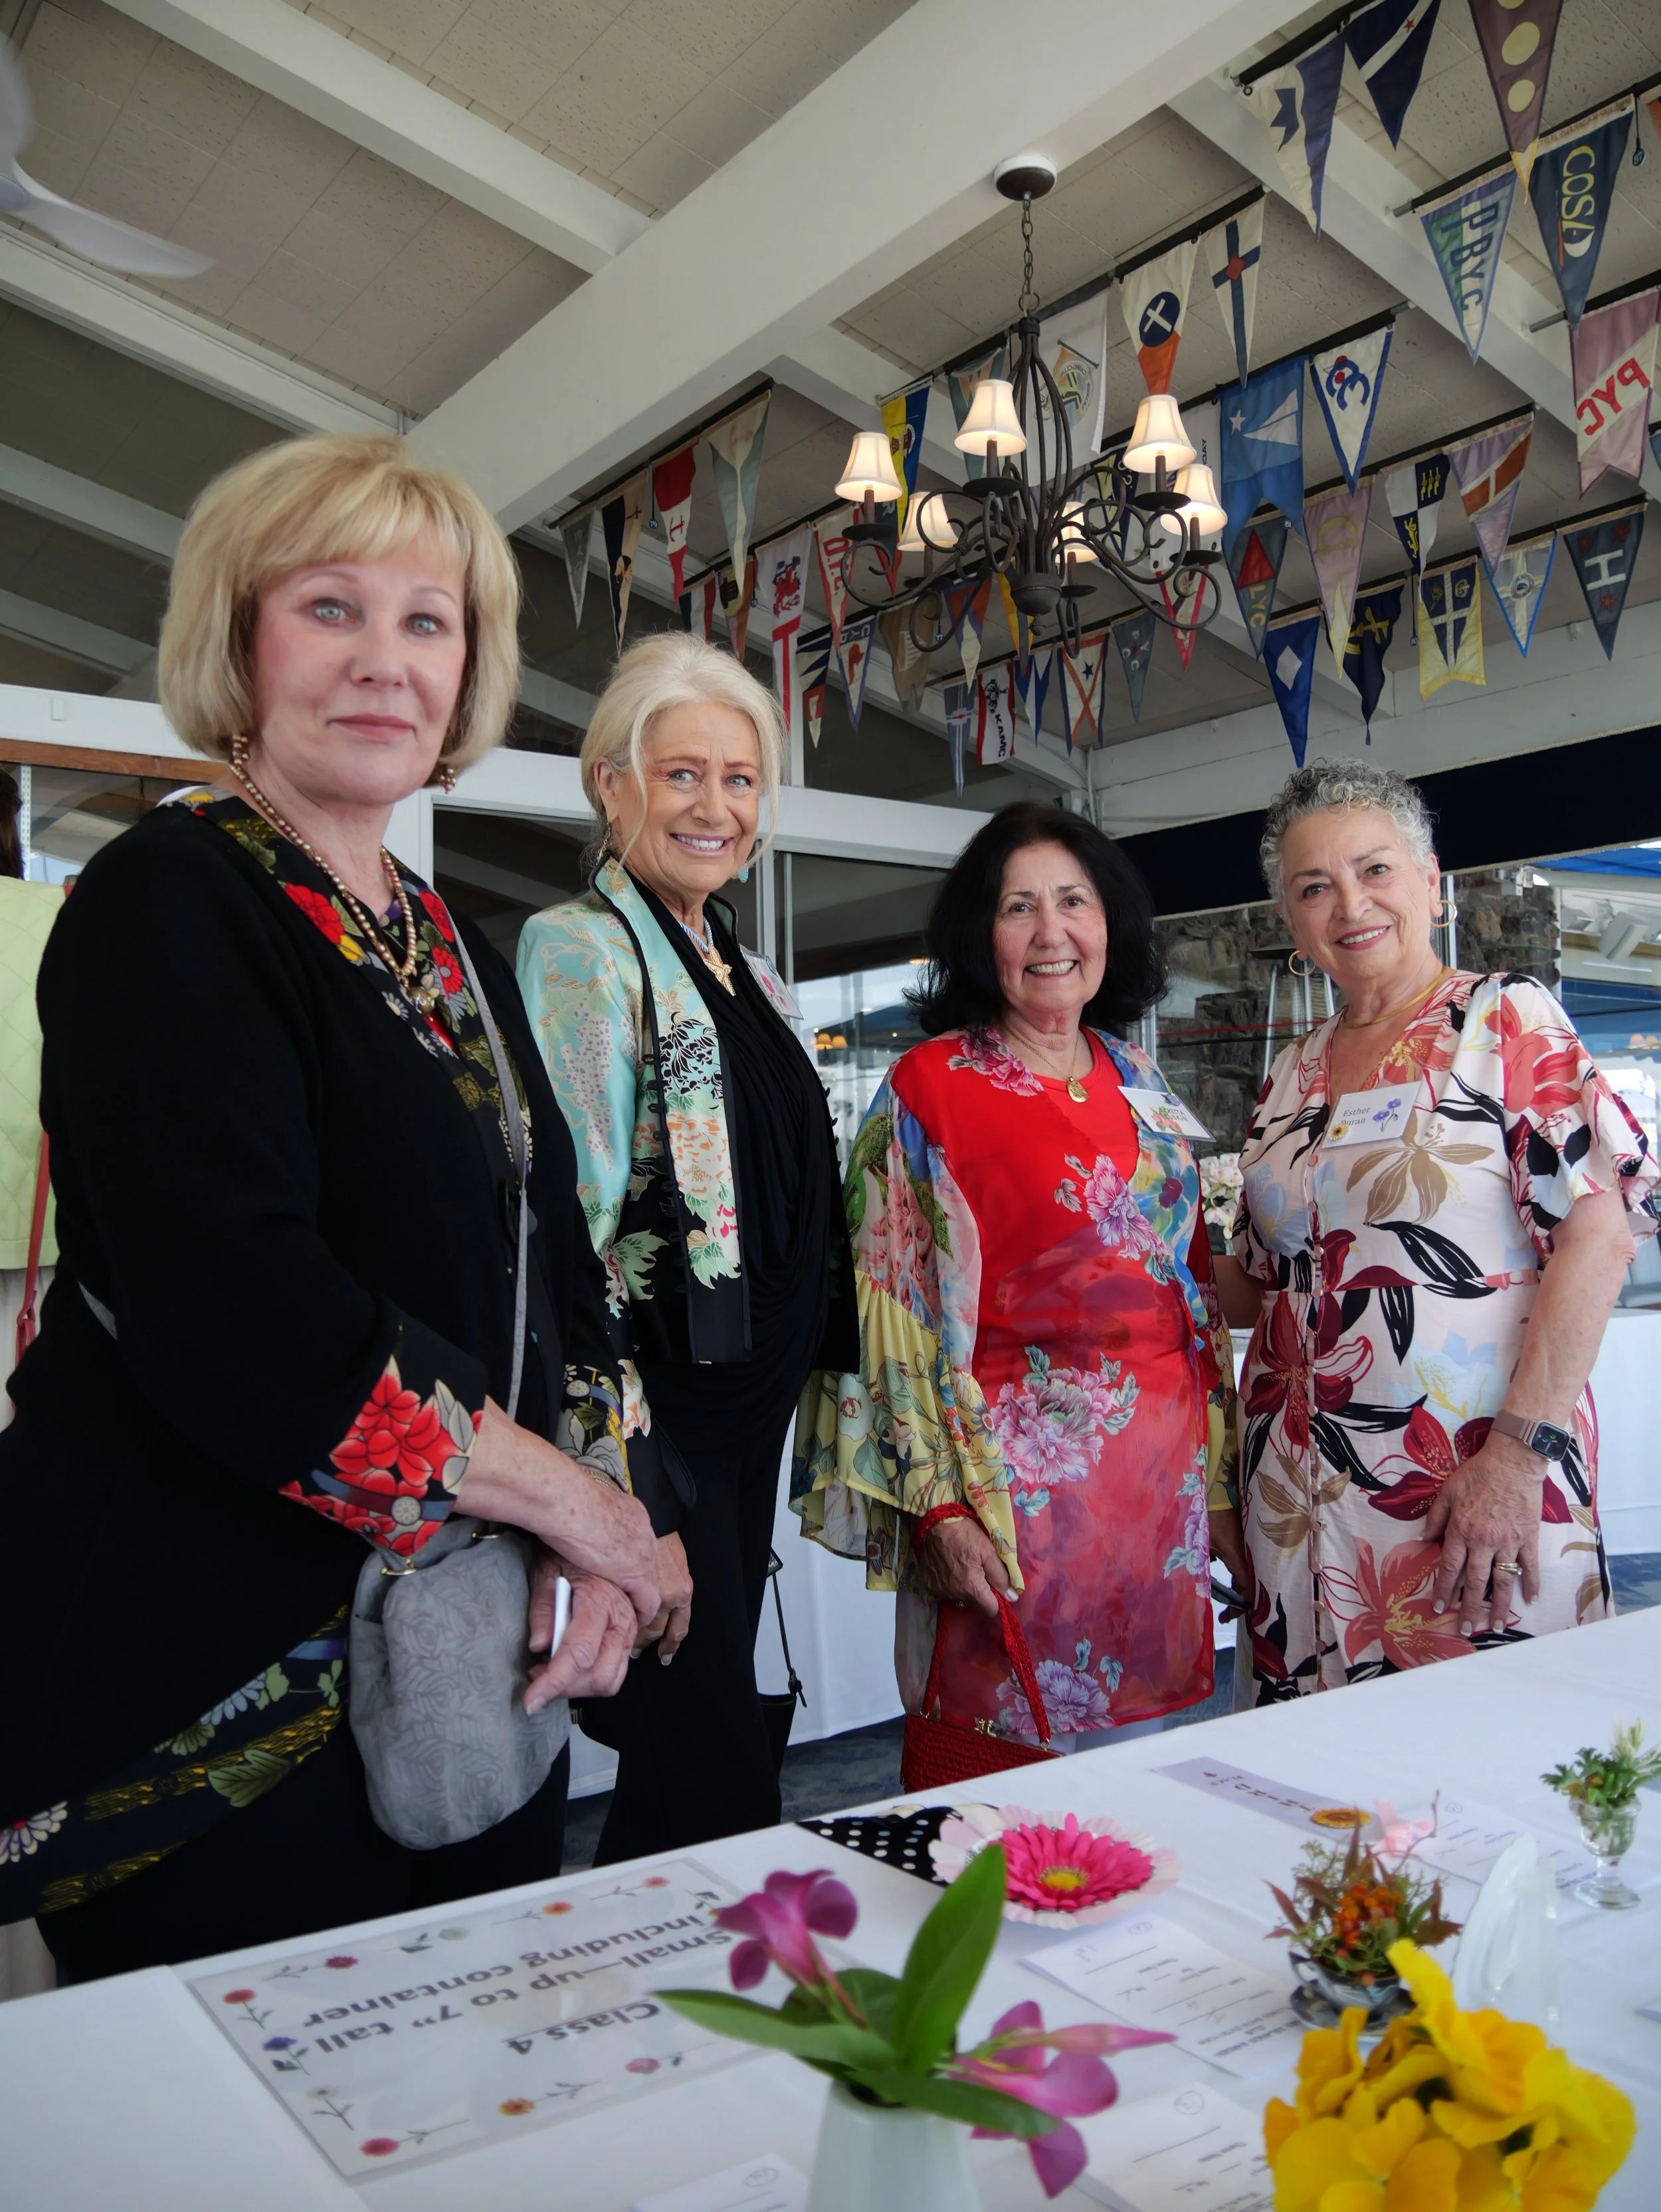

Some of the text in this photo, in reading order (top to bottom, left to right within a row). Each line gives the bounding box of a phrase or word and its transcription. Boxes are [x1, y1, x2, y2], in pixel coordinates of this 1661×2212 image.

[1441, 202, 1499, 311] PBYC
[1585, 549, 1626, 591] H
[1249, 585, 1266, 628] LYC
[995, 713, 1007, 758] KAMC
[1343, 1107, 1371, 1117] Esther
[1234, 1784, 1316, 1813] THIRD
[303, 1916, 699, 2030] including container
[471, 1988, 524, 2009] to
[314, 2019, 397, 2053] tall
[506, 2002, 660, 2057] Class 4
